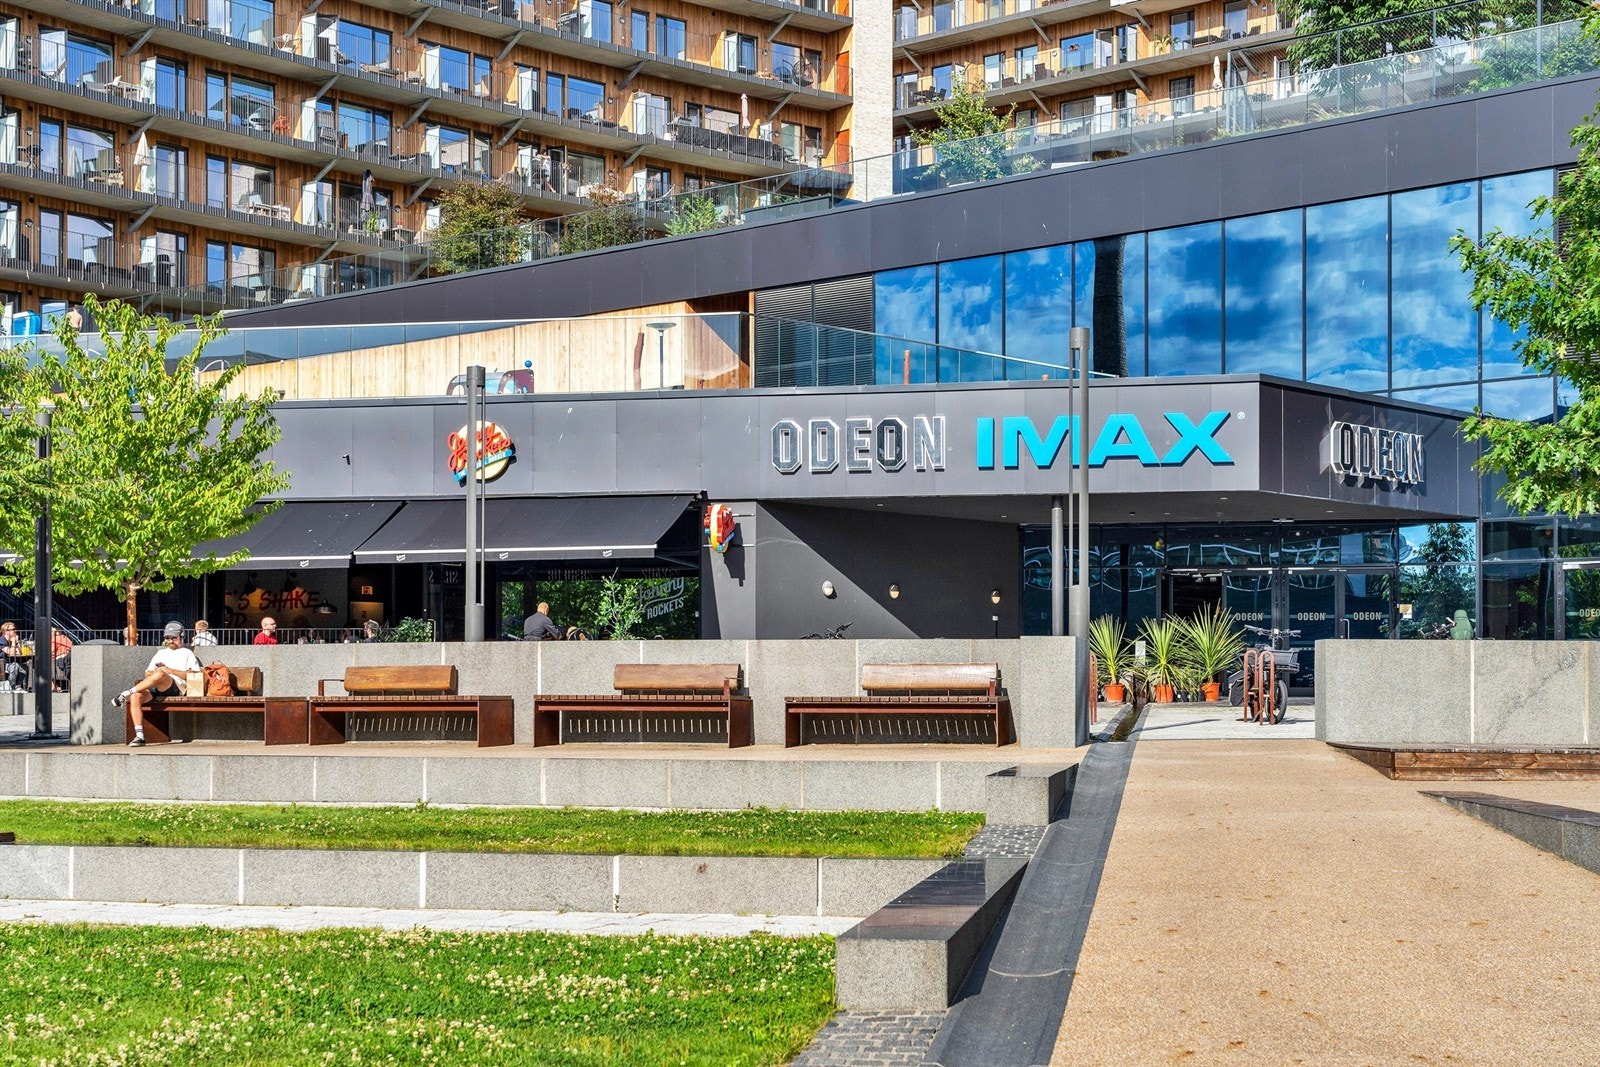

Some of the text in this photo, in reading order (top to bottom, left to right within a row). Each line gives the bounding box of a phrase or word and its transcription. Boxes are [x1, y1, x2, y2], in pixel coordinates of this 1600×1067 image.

[771, 411, 1235, 473] ODEON IMAX
[1330, 420, 1424, 484] ODEON
[260, 588, 320, 612] SHAKE
[636, 577, 685, 609] Johnny
[647, 597, 684, 619] ROCKETS
[1235, 612, 1264, 621] ODEON
[1297, 612, 1326, 621] ODEON
[1353, 611, 1382, 621] ODEON
